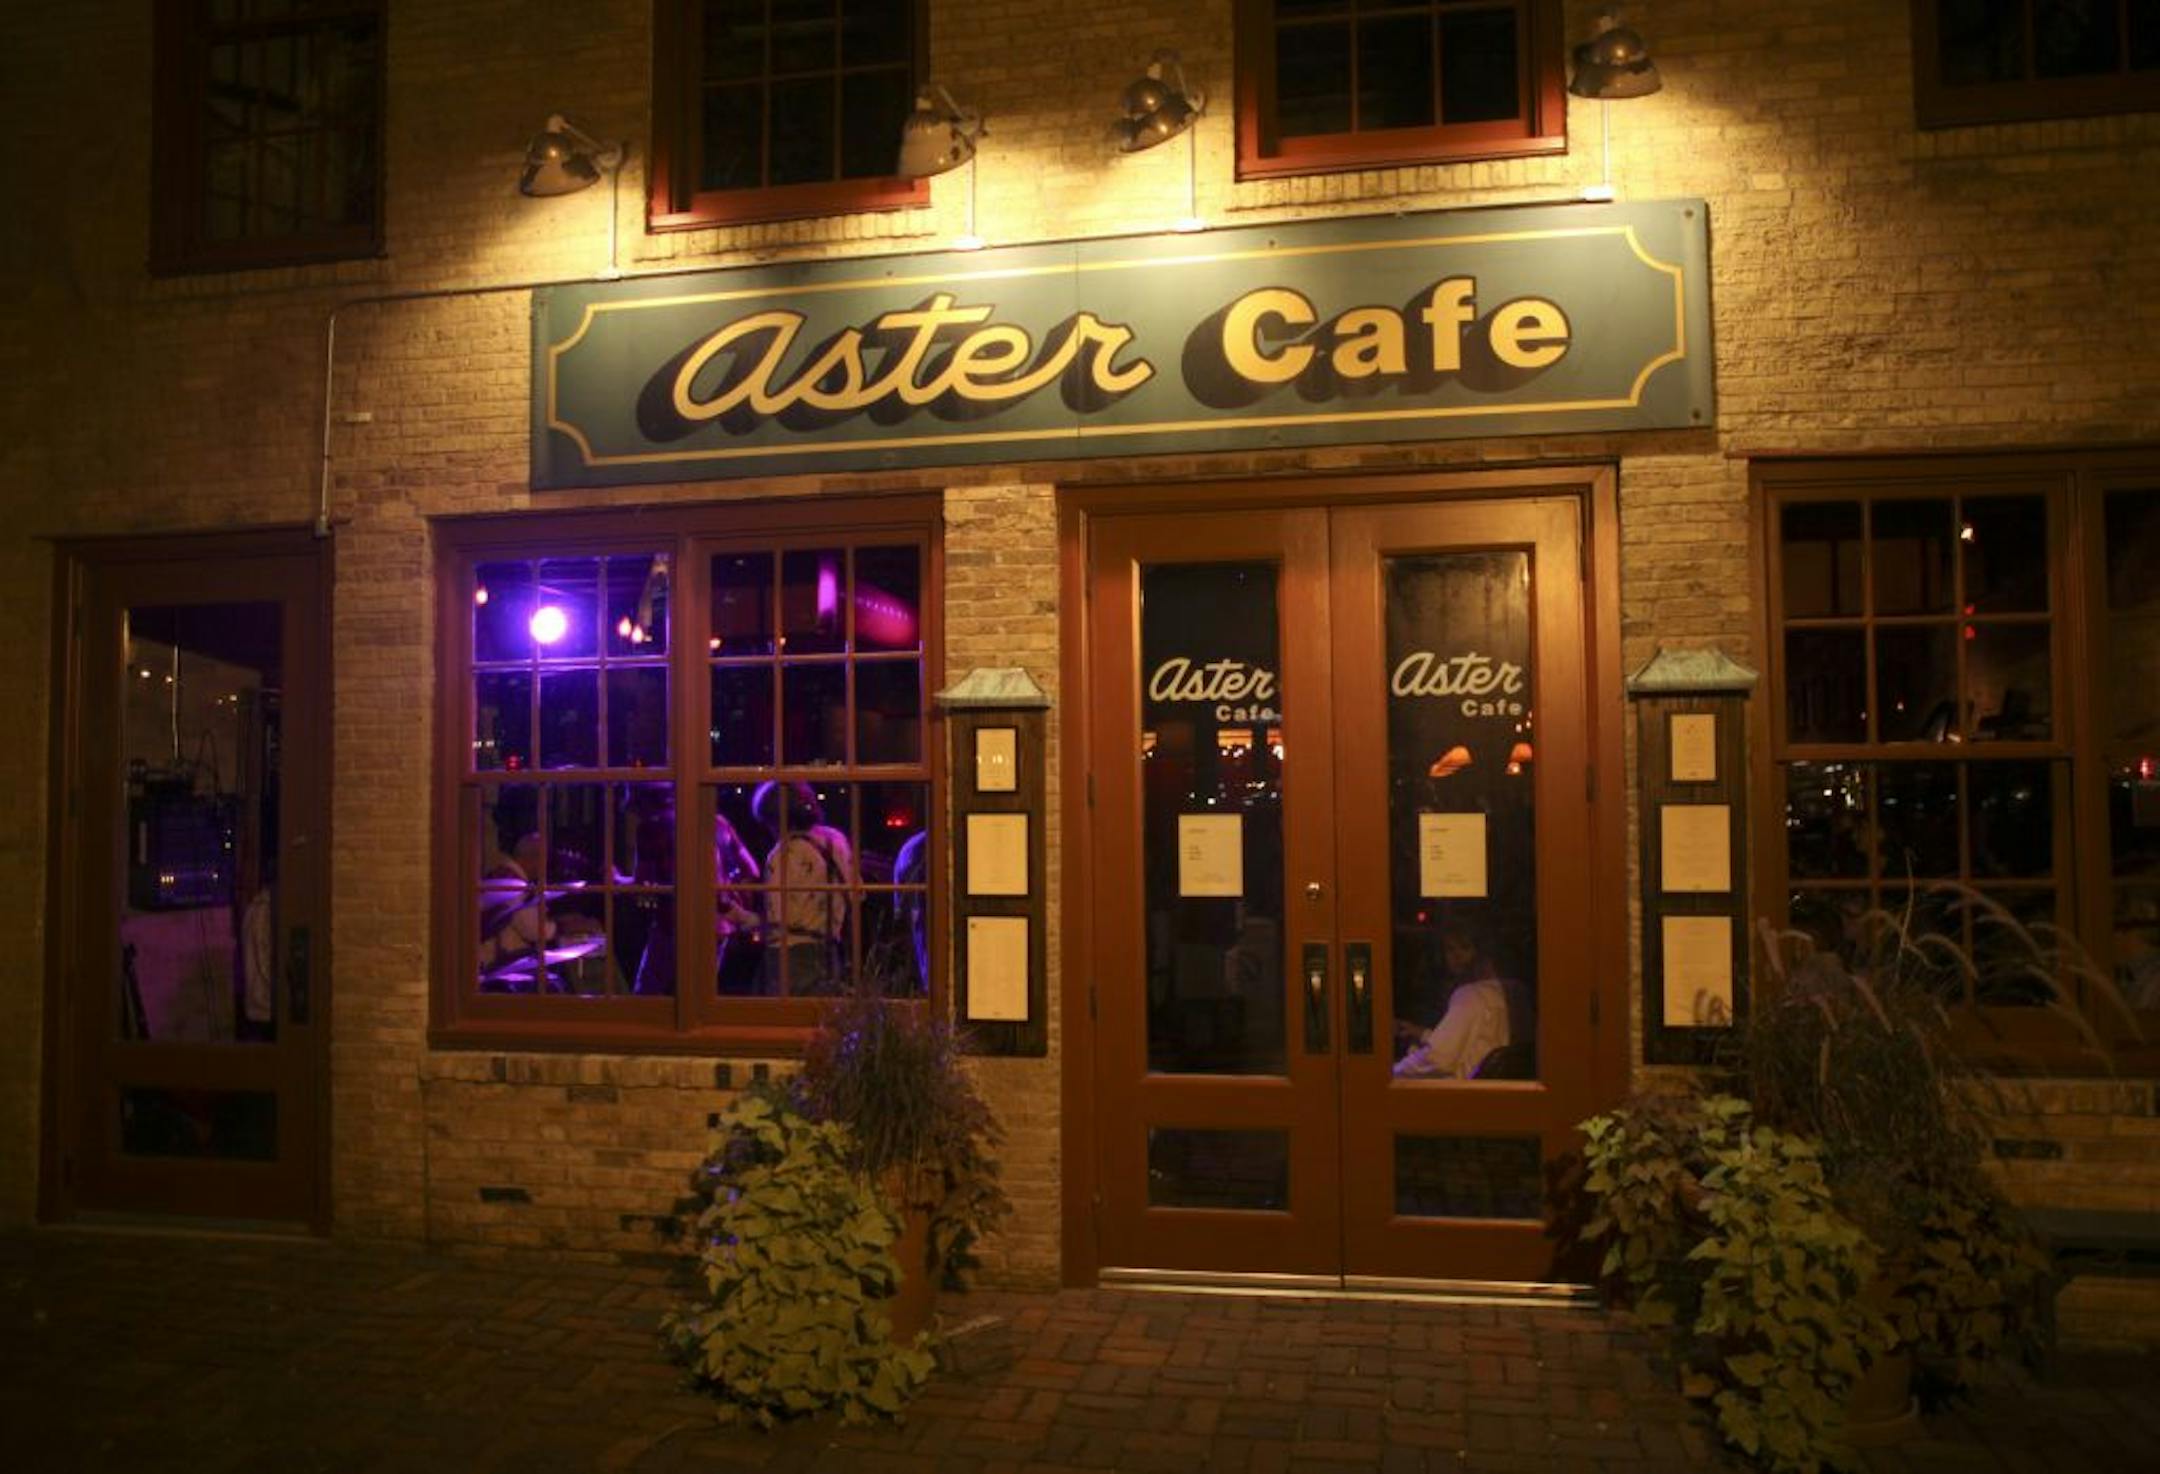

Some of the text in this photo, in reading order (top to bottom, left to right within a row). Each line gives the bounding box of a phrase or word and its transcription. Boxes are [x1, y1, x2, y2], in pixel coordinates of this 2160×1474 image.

[1221, 275, 1571, 384] Cafe
[1215, 703, 1276, 723] Cafe
[1460, 699, 1523, 718] Cafe
